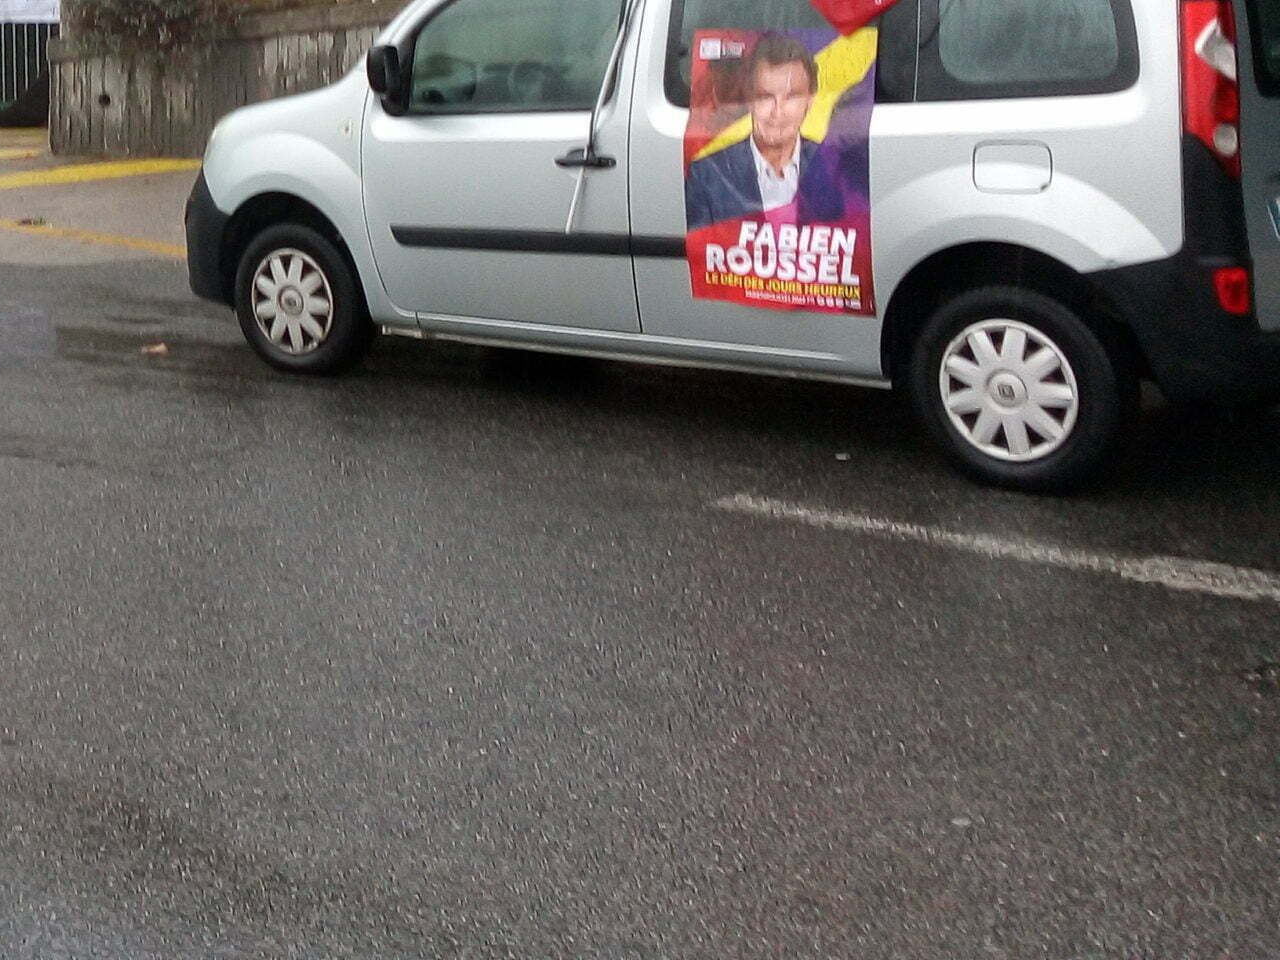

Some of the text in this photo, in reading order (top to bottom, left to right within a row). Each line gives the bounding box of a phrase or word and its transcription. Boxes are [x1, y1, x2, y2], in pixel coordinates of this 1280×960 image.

[738, 221, 857, 256] FABIEN
[706, 243, 860, 285] ROUSSEL
[805, 283, 861, 299] HEUREUX
